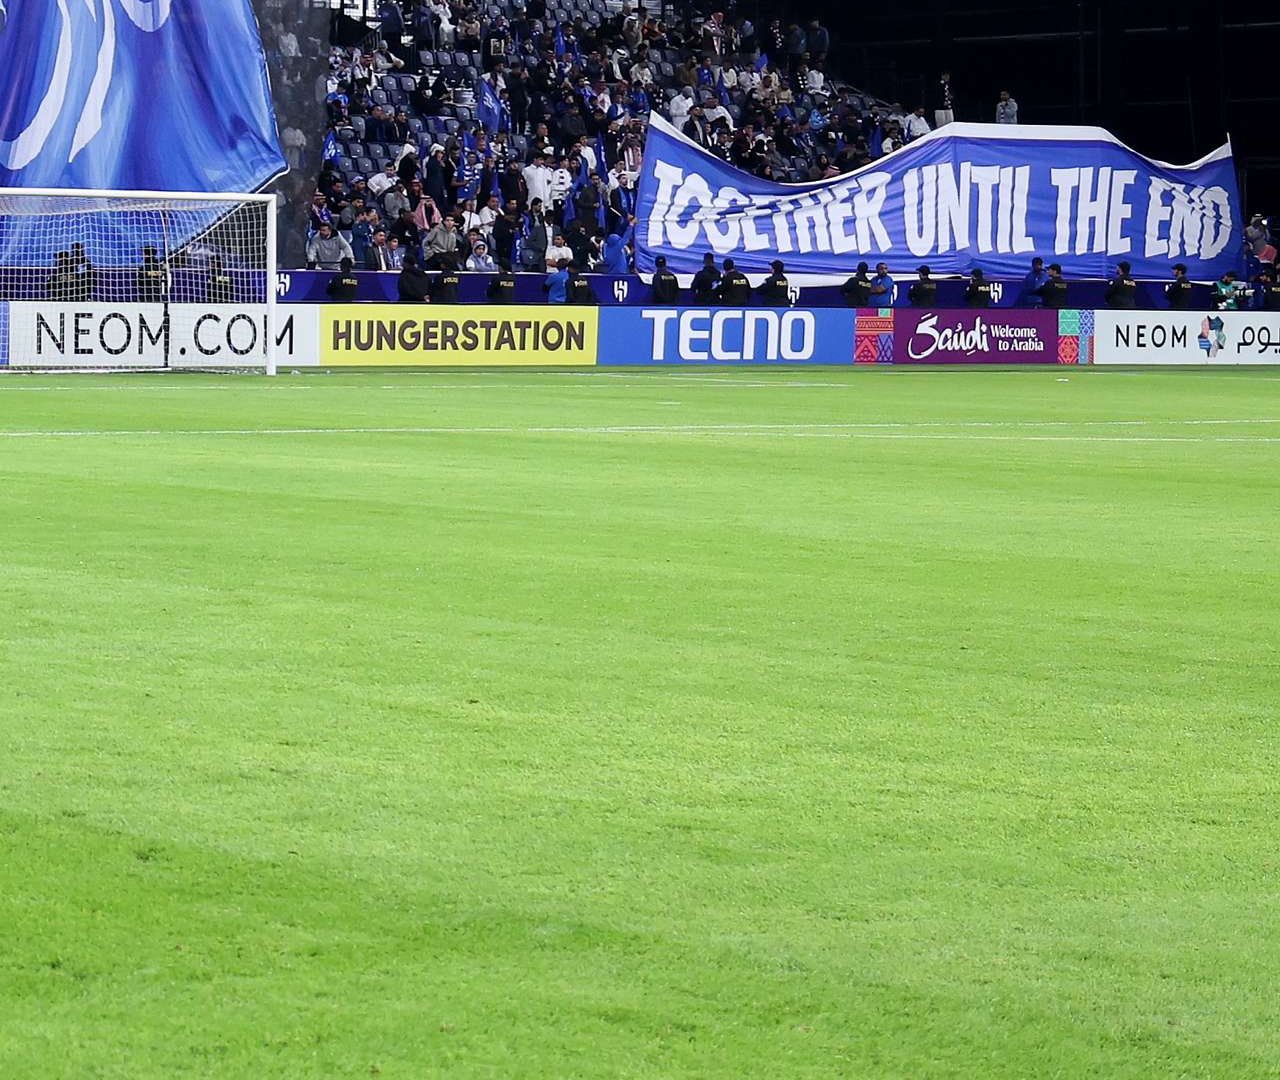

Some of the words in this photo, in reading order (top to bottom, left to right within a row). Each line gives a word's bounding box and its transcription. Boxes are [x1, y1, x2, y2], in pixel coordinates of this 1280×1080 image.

[647, 160, 893, 255] TOGETHER
[903, 161, 1036, 257] UNTIL
[1050, 166, 1138, 256] THE
[1144, 174, 1233, 260] END
[36, 312, 294, 356] NEOM.COM
[332, 319, 586, 352] HUNGERSTATION
[641, 310, 816, 361] TECNO
[908, 313, 990, 359] Saudi
[990, 324, 1037, 338] Welcome
[998, 340, 1009, 351] to
[1011, 339, 1044, 351] Arabia
[1115, 324, 1187, 348] NEOM
[1237, 326, 1280, 354] يوم
